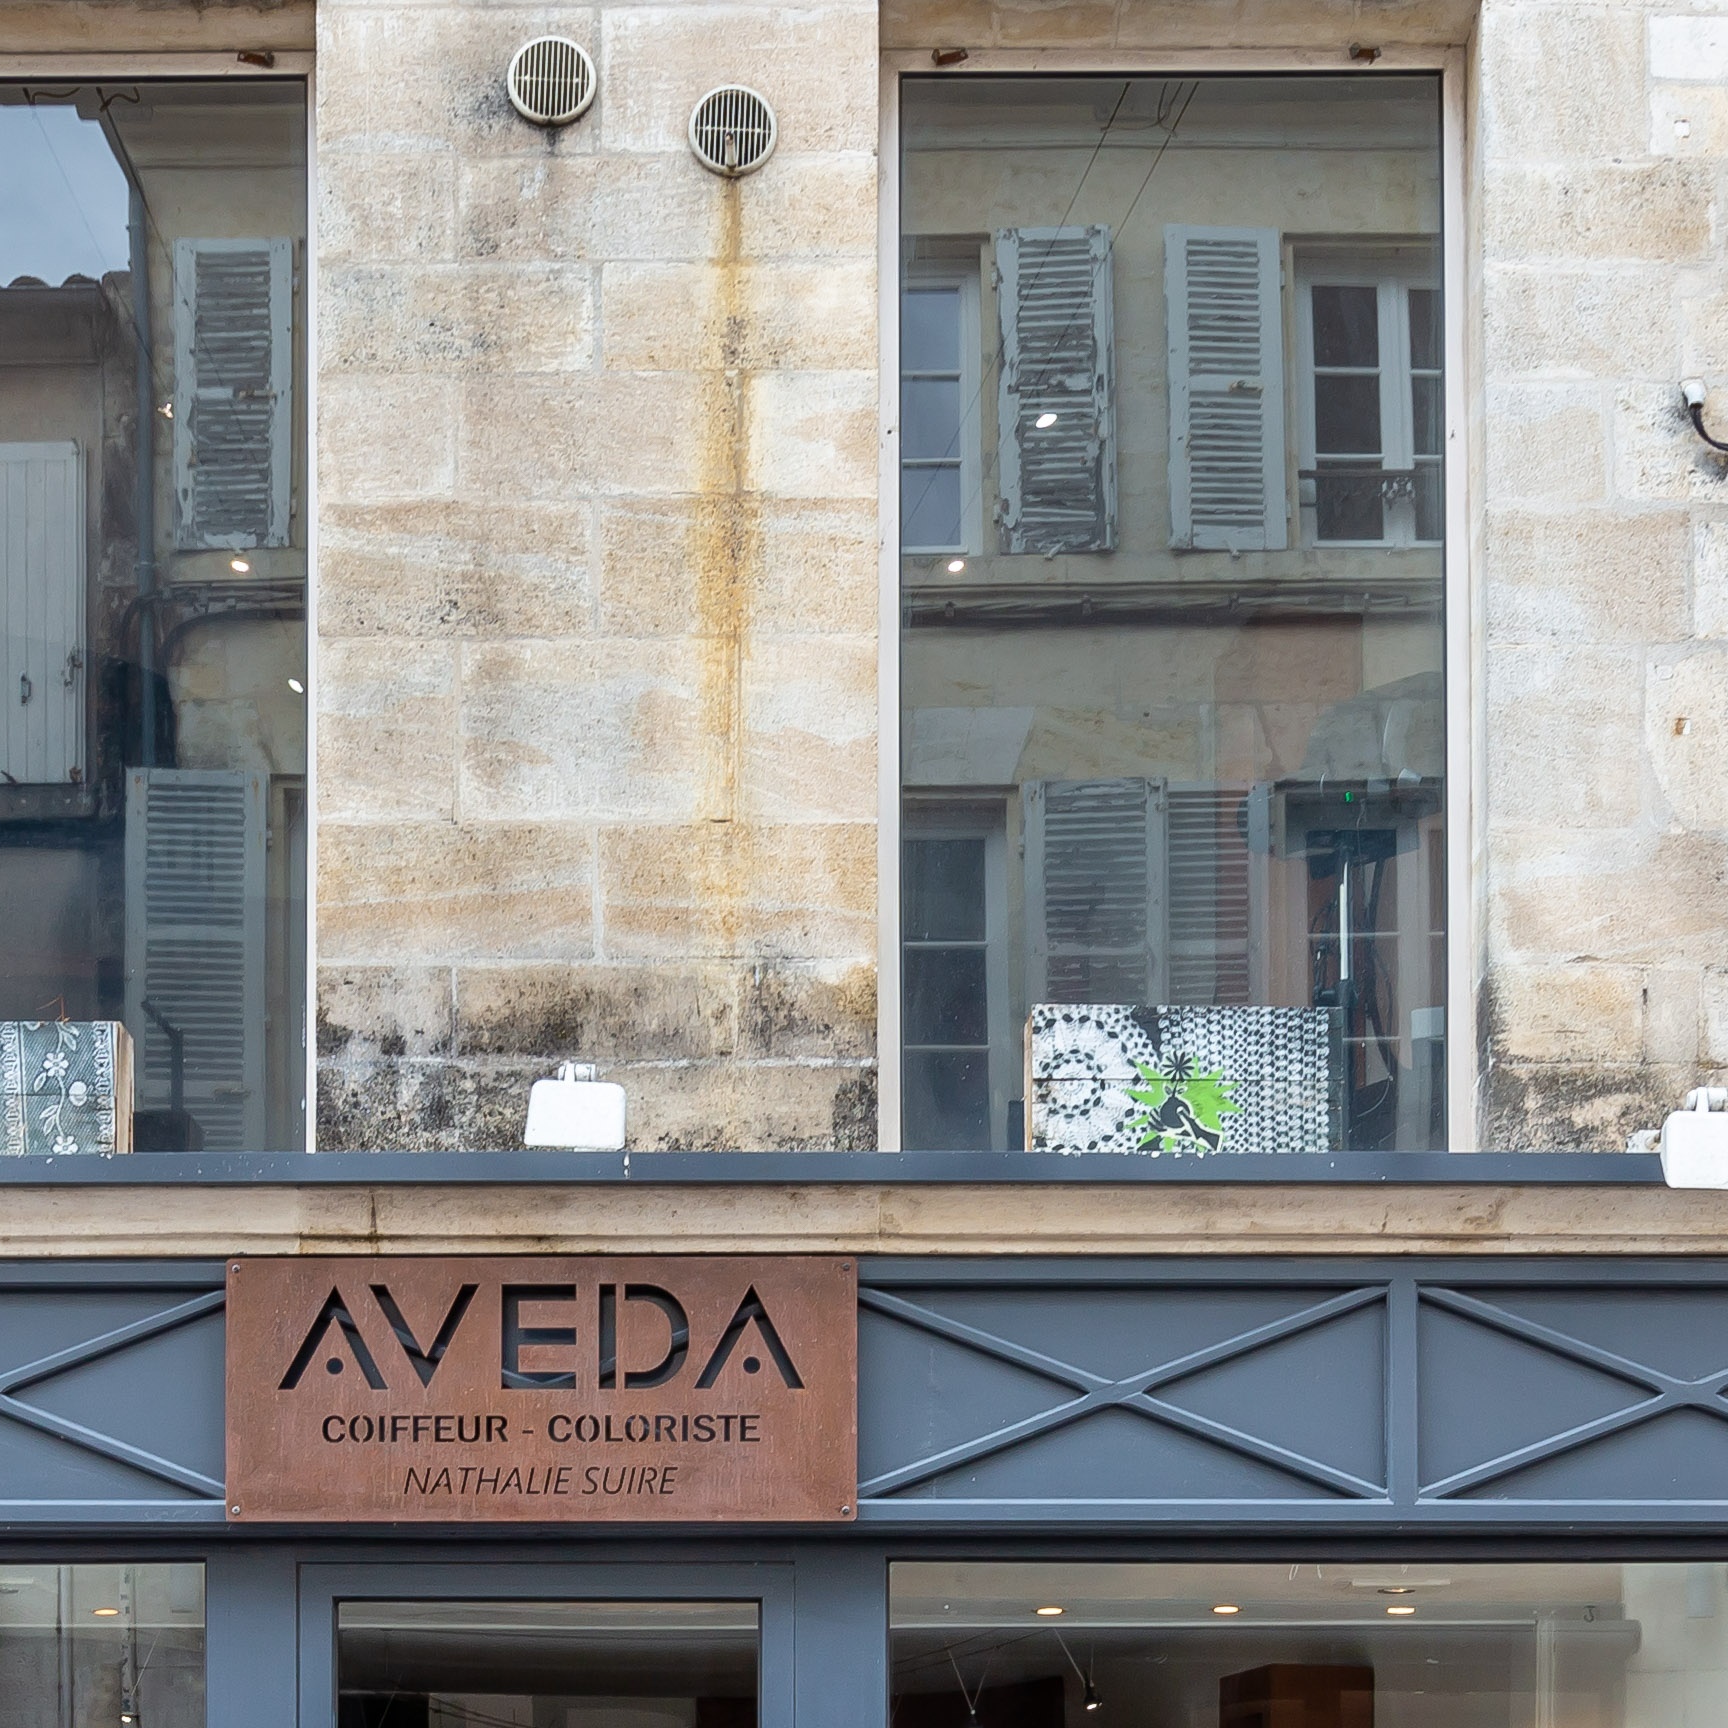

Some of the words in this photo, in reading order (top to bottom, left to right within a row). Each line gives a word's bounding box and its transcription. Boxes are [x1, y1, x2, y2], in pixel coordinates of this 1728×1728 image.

[278, 1283, 805, 1391] AVEDA
[321, 1413, 508, 1444] COIFFEUR
[547, 1413, 761, 1444] COLORISTE
[403, 1466, 572, 1496] NATHALIE
[581, 1466, 678, 1496] SUIRE
